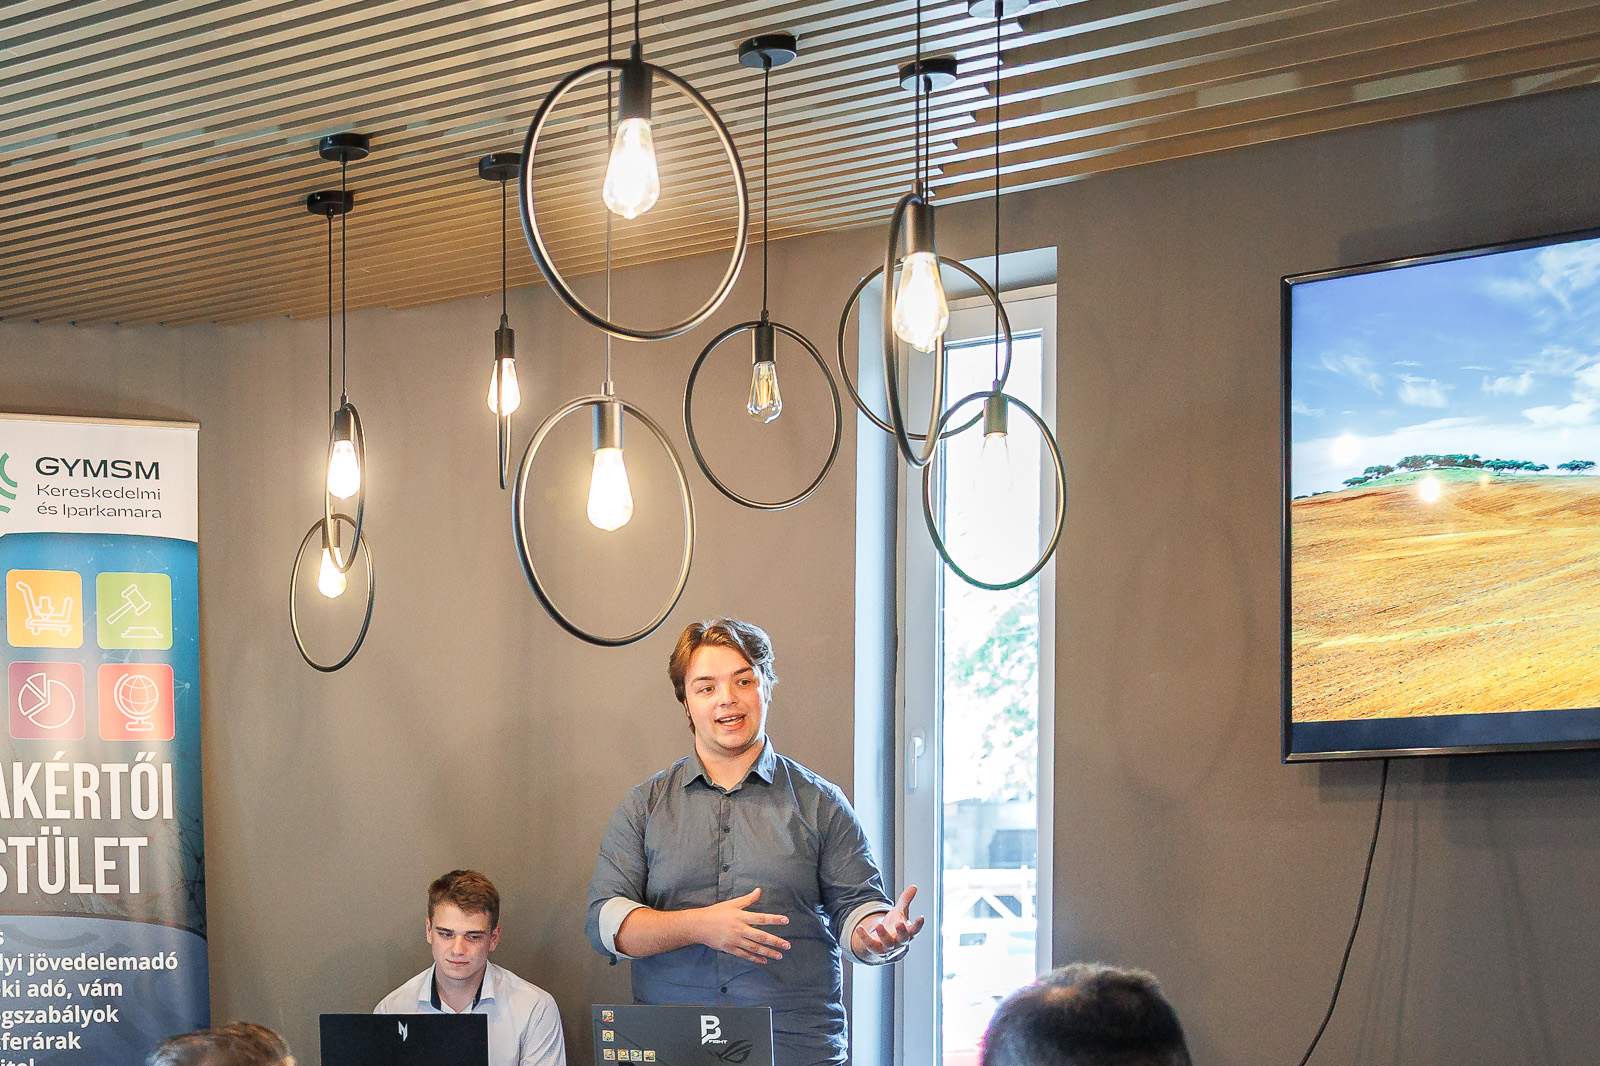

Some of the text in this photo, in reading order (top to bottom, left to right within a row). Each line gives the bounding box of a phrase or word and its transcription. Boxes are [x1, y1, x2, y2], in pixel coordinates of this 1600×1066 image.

[35, 456, 160, 480] GYMSM
[36, 483, 161, 501] Kereskedelmi
[36, 502, 162, 519] és Iparkamara
[27, 951, 178, 974] jövedelemadó
[28, 979, 73, 1000] adó,
[78, 979, 123, 997] vám
